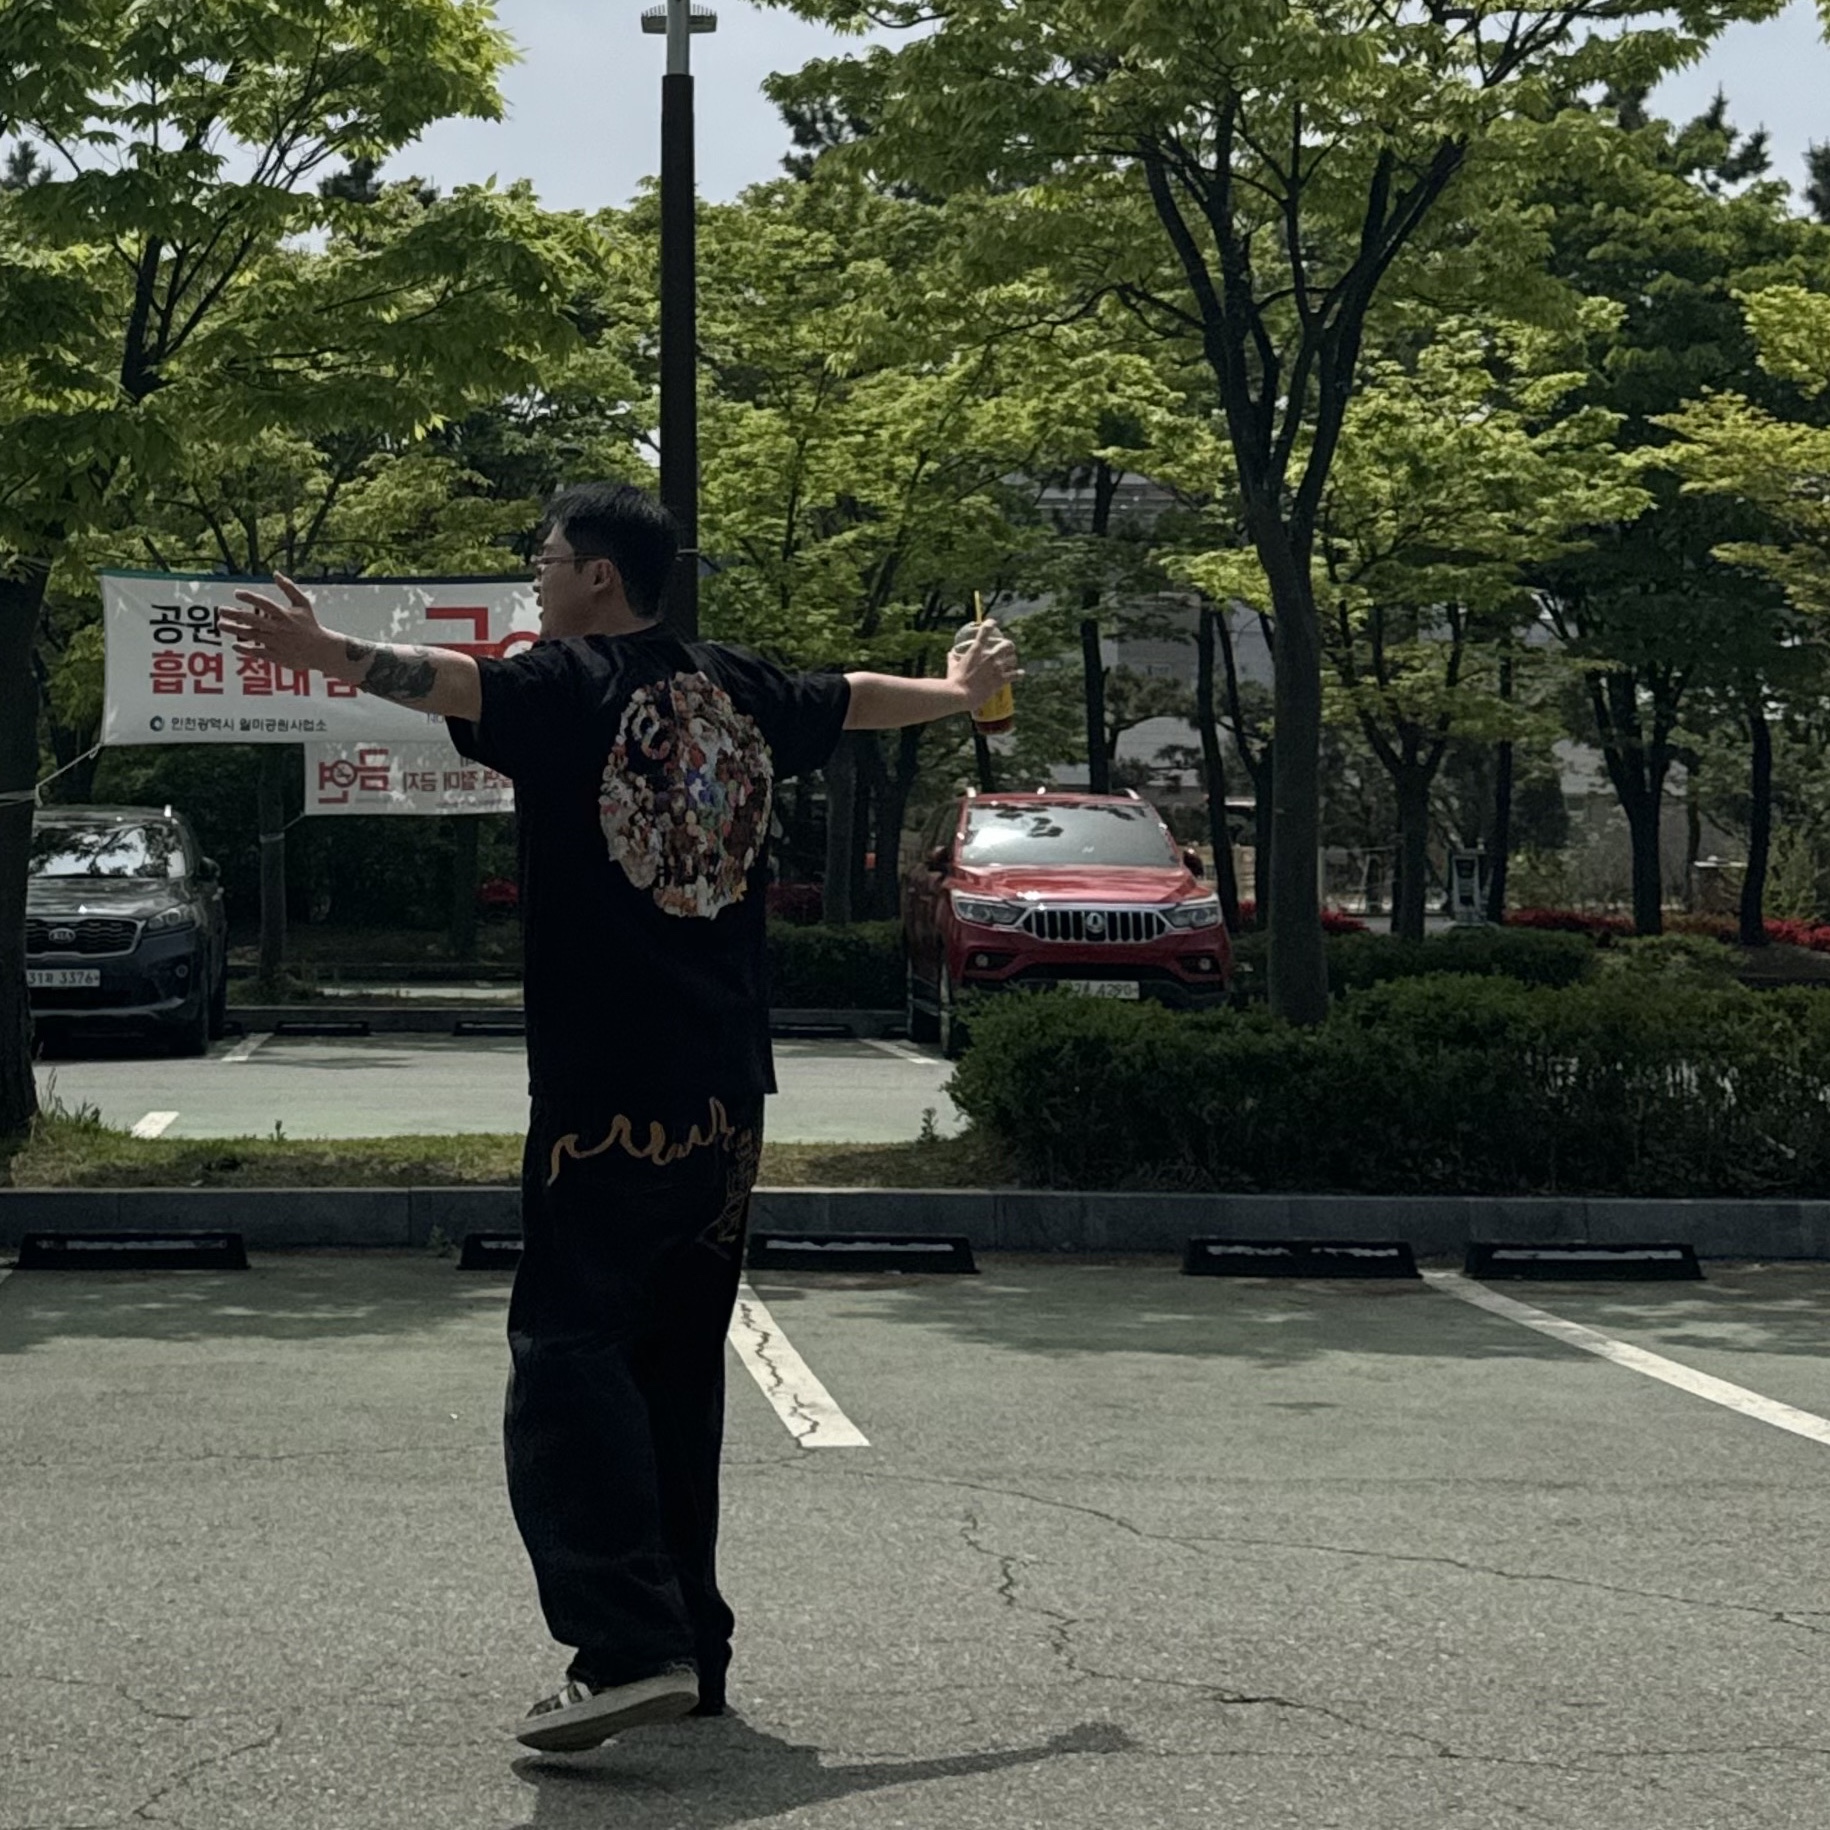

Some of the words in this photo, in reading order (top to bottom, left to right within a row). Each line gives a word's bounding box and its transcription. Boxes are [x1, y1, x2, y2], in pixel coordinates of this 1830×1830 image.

[149, 604, 222, 646] 공원
[149, 650, 224, 695] 흡연
[171, 717, 235, 732] 인천광역시
[60, 971, 94, 984] 3376
